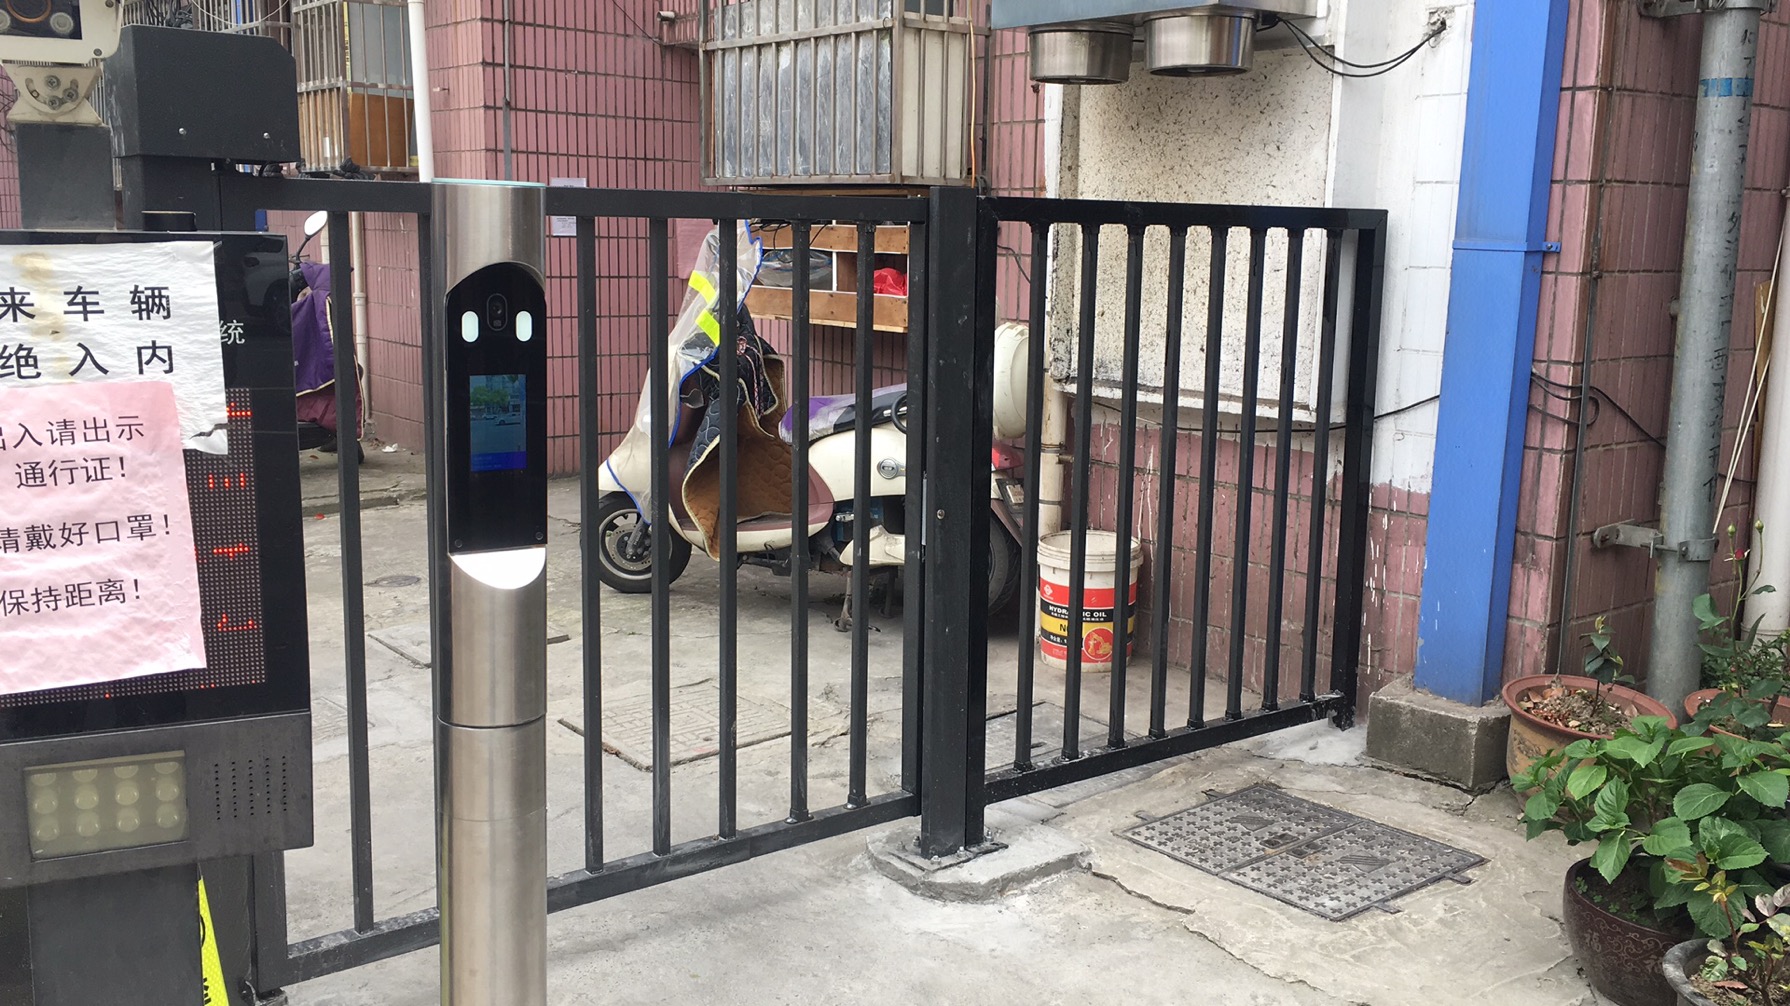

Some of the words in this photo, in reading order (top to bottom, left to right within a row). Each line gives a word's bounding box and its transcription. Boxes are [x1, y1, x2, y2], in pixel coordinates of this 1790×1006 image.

[0, 284, 172, 322] 来车辆
[219, 319, 246, 345] 统
[0, 340, 174, 380] 绝入内
[0, 414, 145, 452] 入请出示
